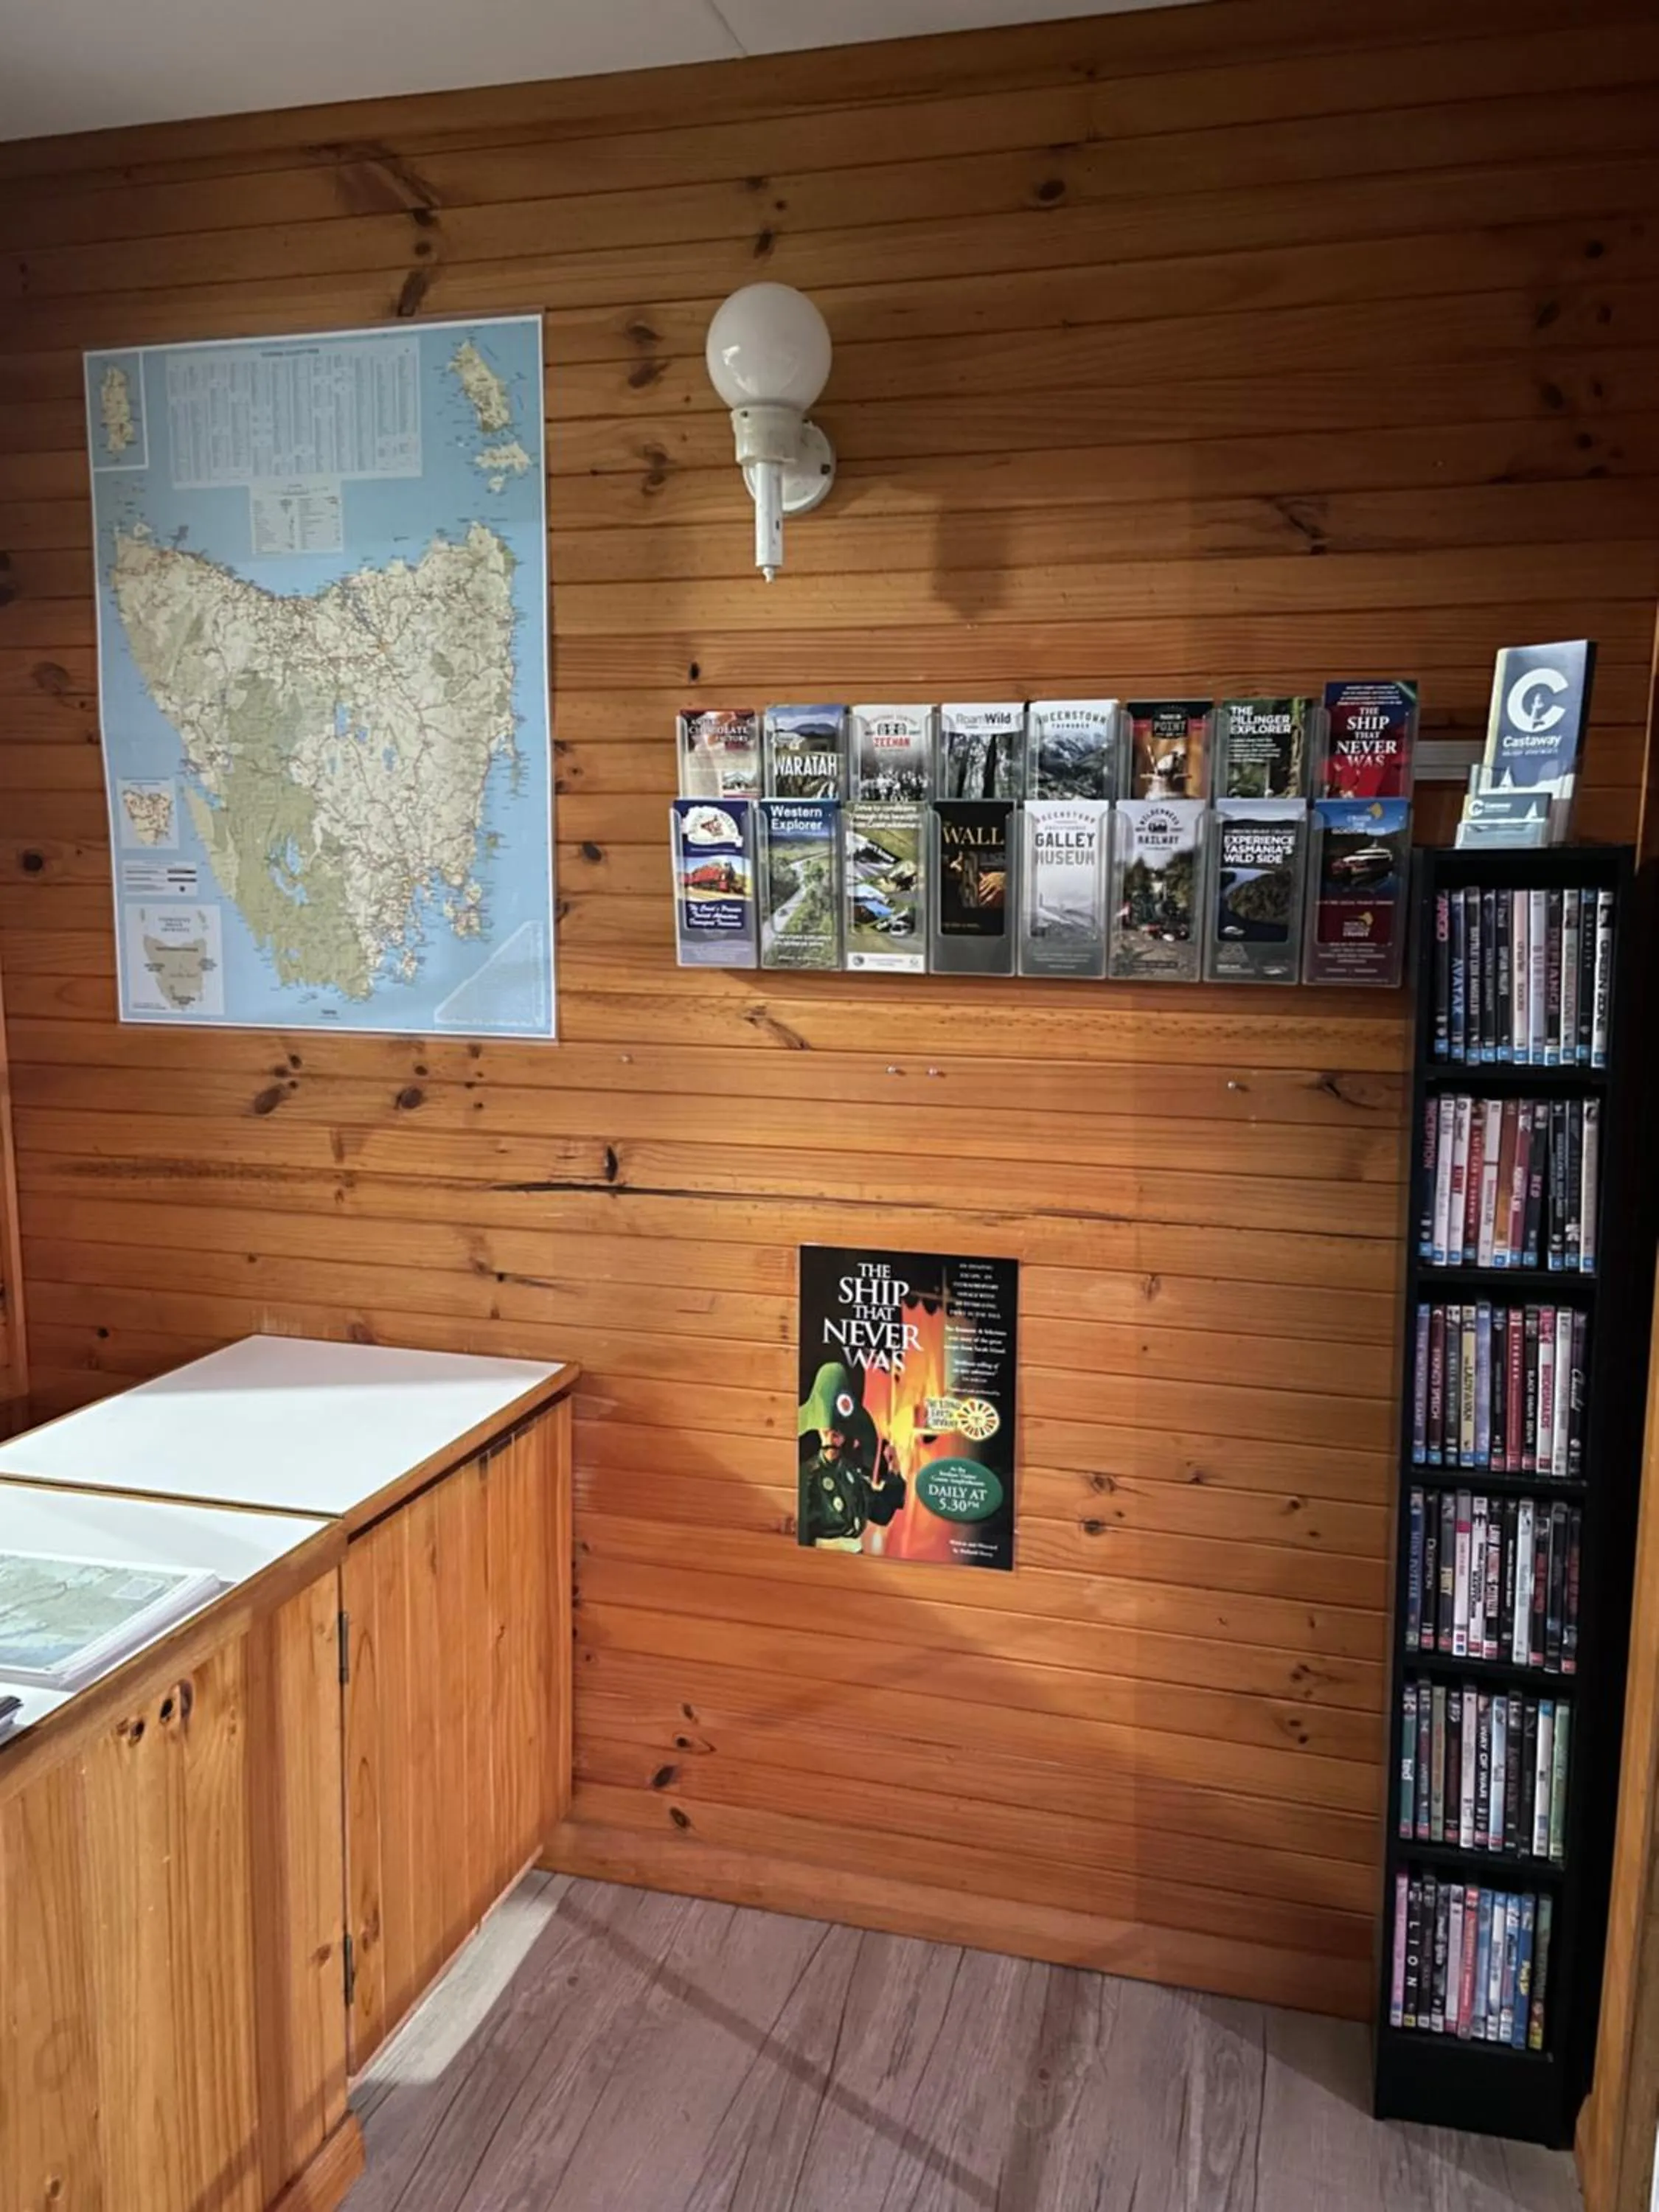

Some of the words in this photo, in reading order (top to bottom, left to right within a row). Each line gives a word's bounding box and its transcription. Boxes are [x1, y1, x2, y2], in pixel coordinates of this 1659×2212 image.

[1231, 706, 1253, 714] THE
[1231, 714, 1290, 724] PILLINGER
[1230, 724, 1291, 734] EXPLORER
[1347, 717, 1390, 730] SHIP
[874, 738, 911, 747] ZEEHAN
[1335, 740, 1397, 754] NEVER
[1503, 735, 1562, 748] Castaway
[774, 755, 838, 776] WARATAH
[1346, 755, 1385, 767] WAS
[771, 806, 822, 818] Western
[771, 819, 823, 832] Explorer
[942, 827, 1004, 845] WALL
[1035, 832, 1096, 847] GALLEY
[1224, 835, 1295, 845] EXPERIENCE
[1224, 845, 1293, 855] TASMANIA'S
[1034, 850, 1095, 865] MUSEUM
[1224, 855, 1254, 863] WILD
[1256, 855, 1283, 863] SIDE
[1437, 896, 1448, 942] ARGO
[1470, 927, 1479, 956] BATTLE
[1585, 914, 1593, 968] GRAVITY
[1470, 959, 1479, 977] LOS
[1533, 945, 1543, 998] BURNT
[1548, 928, 1559, 1015] DEFIANCE
[1598, 940, 1609, 987] GREEN
[1451, 958, 1464, 1015] AVATAR
[1470, 978, 1479, 1015] ANGELES
[1596, 992, 1606, 1032] ZONE
[1424, 1101, 1436, 1169] INCEPTION
[1530, 1175, 1542, 1197] RED
[1468, 1189, 1476, 1224] DARWIN
[858, 1263, 891, 1279] THE
[838, 1276, 910, 1307] SHIP
[852, 1304, 895, 1321] THAT
[822, 1318, 925, 1351] NEVER
[842, 1346, 905, 1373] WAS
[1464, 1366, 1473, 1391] LADY
[1431, 1388, 1441, 1419] SPEECH
[1464, 1402, 1473, 1422] VAN
[1415, 1402, 1424, 1427] GAME
[929, 1484, 967, 1498] DAILY
[970, 1489, 987, 1500] AT
[1488, 1525, 1500, 1545] LAW
[1425, 1538, 1436, 1590] DECEPTION
[1409, 1559, 1419, 1599] POTTER
[1441, 1567, 1453, 1596] FURY
[1479, 1725, 1487, 1749] WAY
[1402, 1759, 1413, 1781] ted
[1479, 1753, 1488, 1768] OF
[1407, 1921, 1420, 1987] LION
